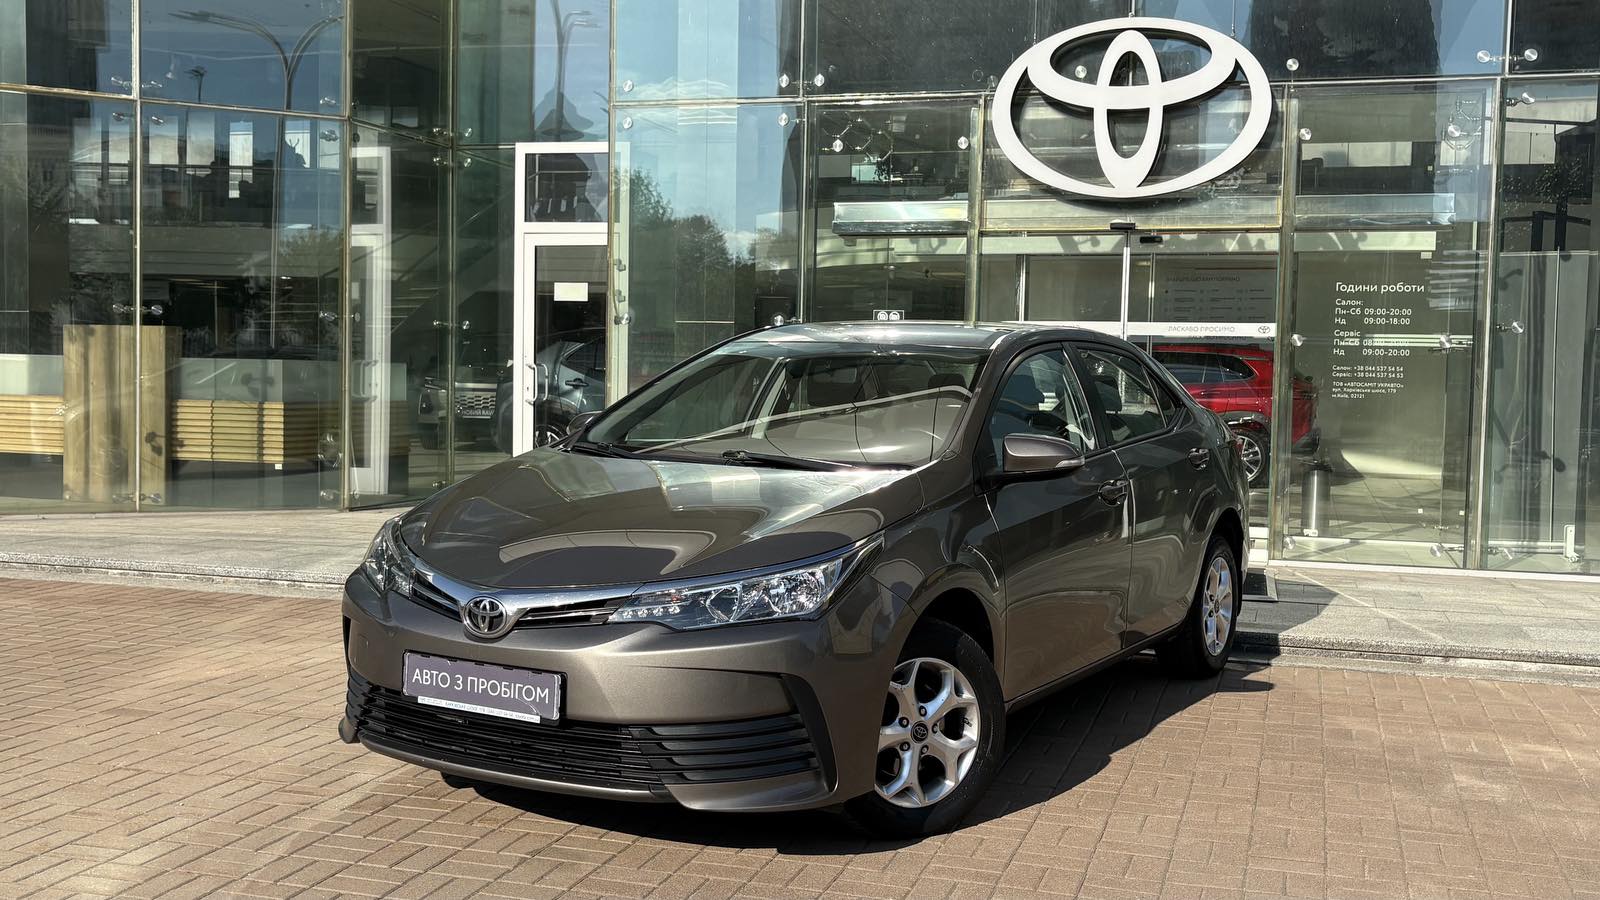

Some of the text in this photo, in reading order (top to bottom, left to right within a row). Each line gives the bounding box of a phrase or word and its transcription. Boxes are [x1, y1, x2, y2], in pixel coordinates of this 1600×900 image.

[1335, 282, 1425, 294] Години роботи
[1364, 308, 1412, 316] 09:00-20:00
[1334, 317, 1411, 325] Нд 09:00-18:00
[1333, 348, 1410, 356] Нд 09:00-20:00
[412, 668, 451, 688] АВТО
[467, 676, 549, 704] ПРОБІГОМ
